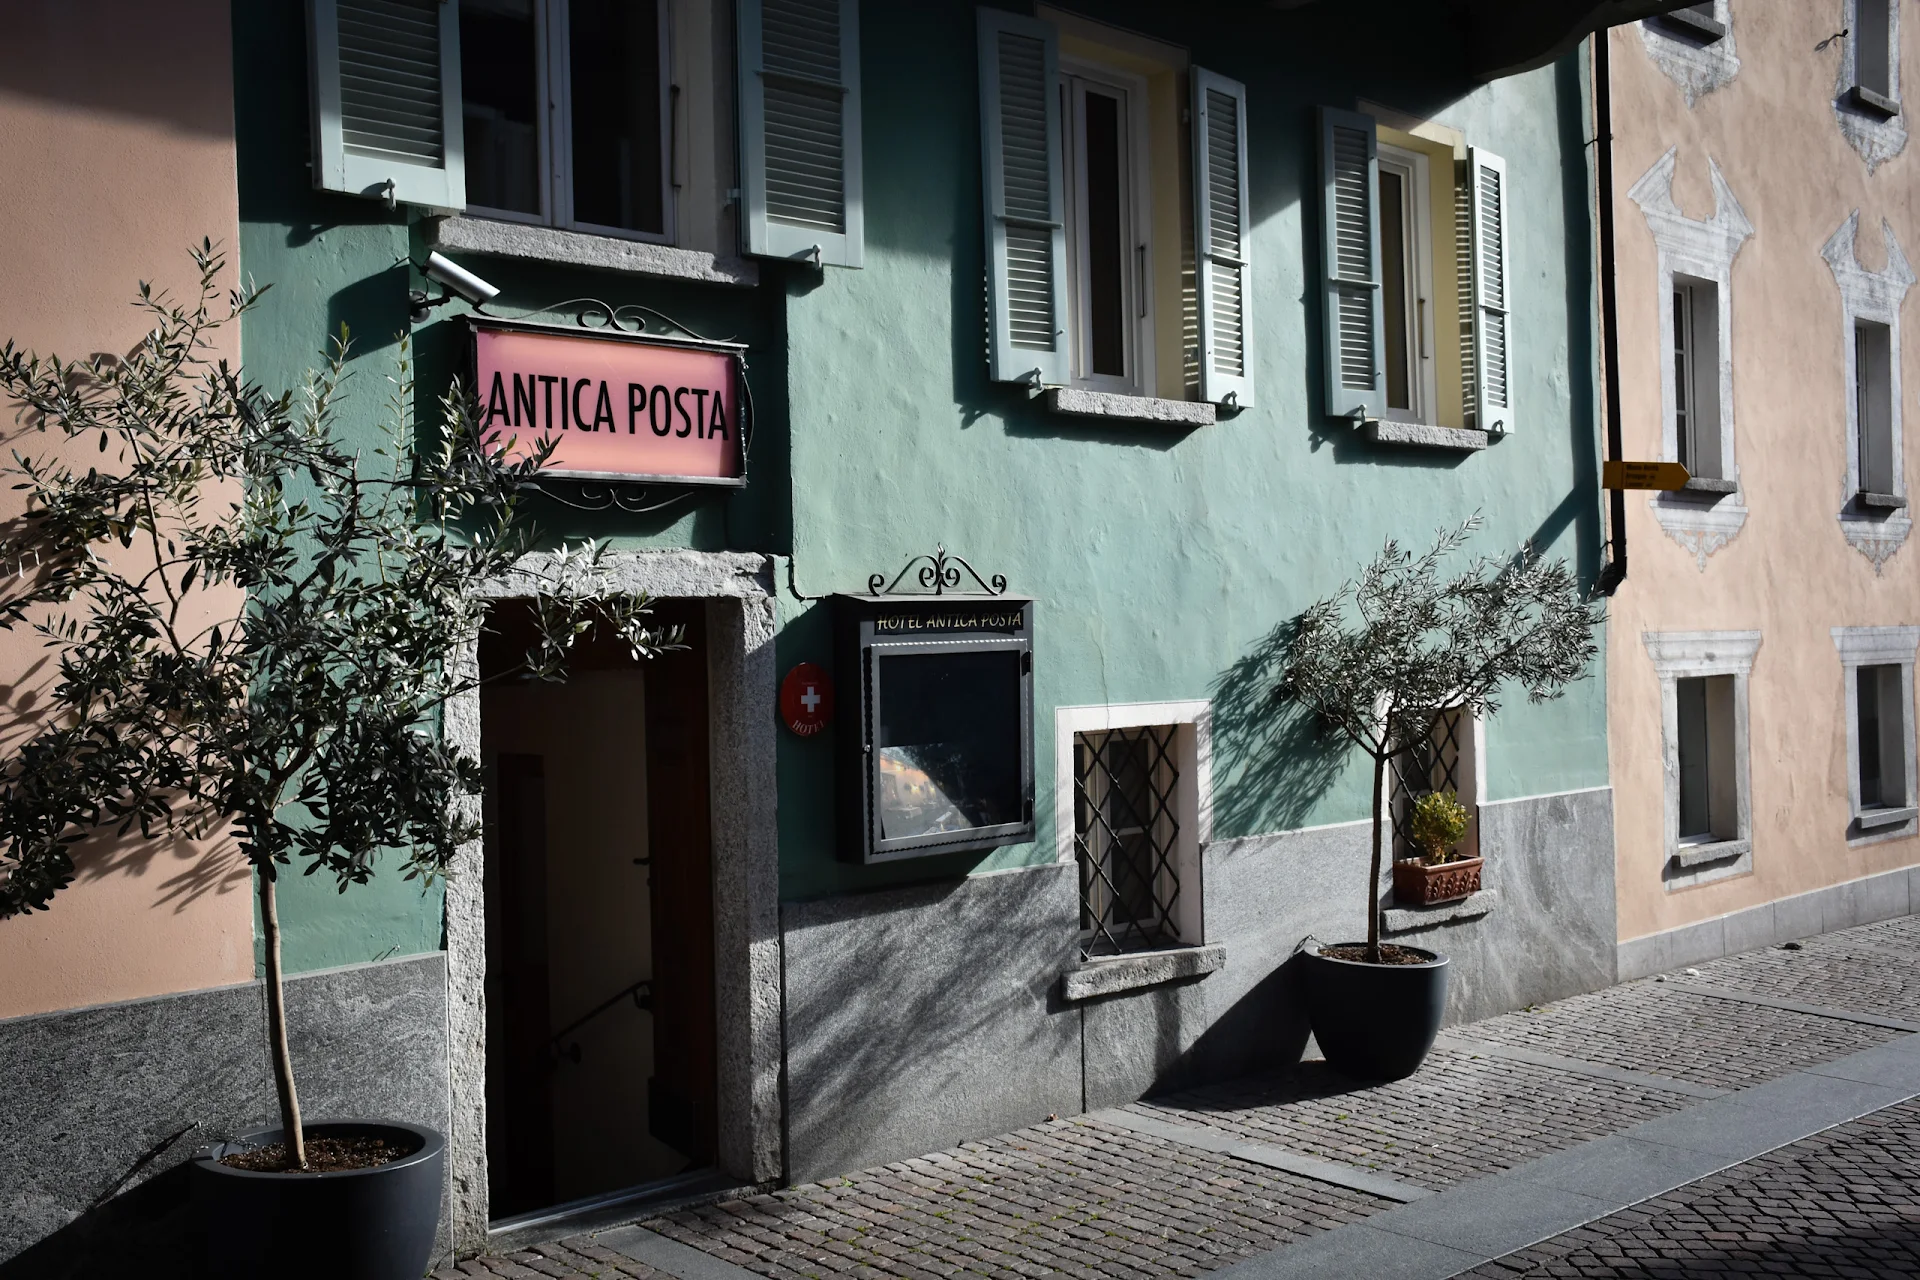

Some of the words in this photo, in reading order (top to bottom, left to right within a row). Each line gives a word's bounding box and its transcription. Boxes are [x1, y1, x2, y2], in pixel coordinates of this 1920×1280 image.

[486, 371, 617, 433] ANTICA
[628, 382, 729, 441] POSTA
[877, 611, 923, 631] HOTEL
[926, 611, 978, 629] ANTICA
[981, 611, 1022, 628] POSTA
[792, 719, 825, 735] HOTEL
